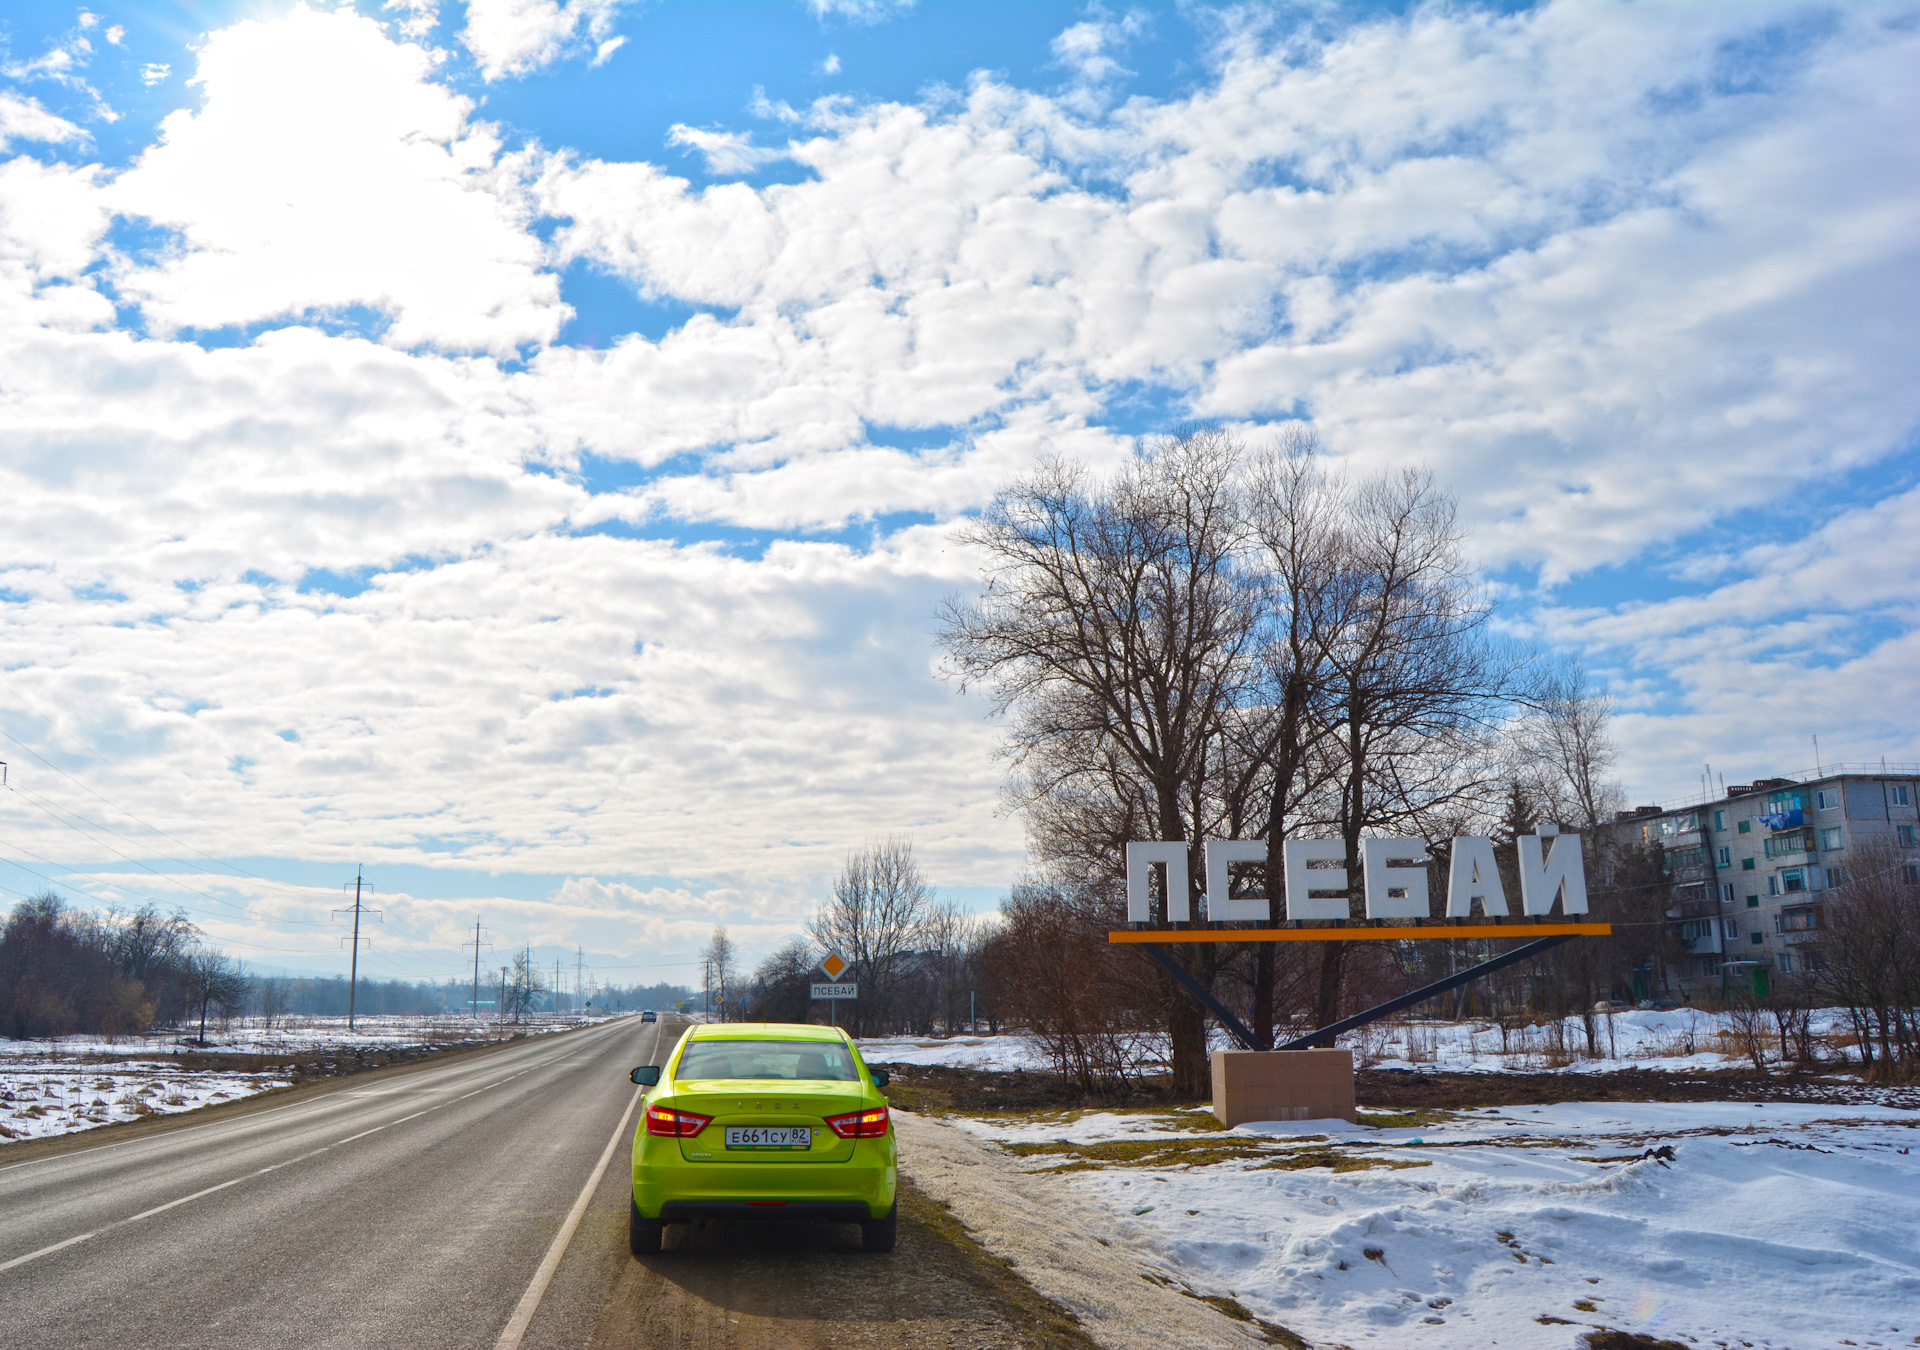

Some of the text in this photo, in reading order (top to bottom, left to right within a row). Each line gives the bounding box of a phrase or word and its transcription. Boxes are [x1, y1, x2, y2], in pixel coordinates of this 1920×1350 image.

[1126, 824, 1588, 922] ПСЕБАЙ
[813, 985, 854, 995] ПСЕБАЙ
[738, 1101, 799, 1110] LADA
[792, 1129, 805, 1139] 82
